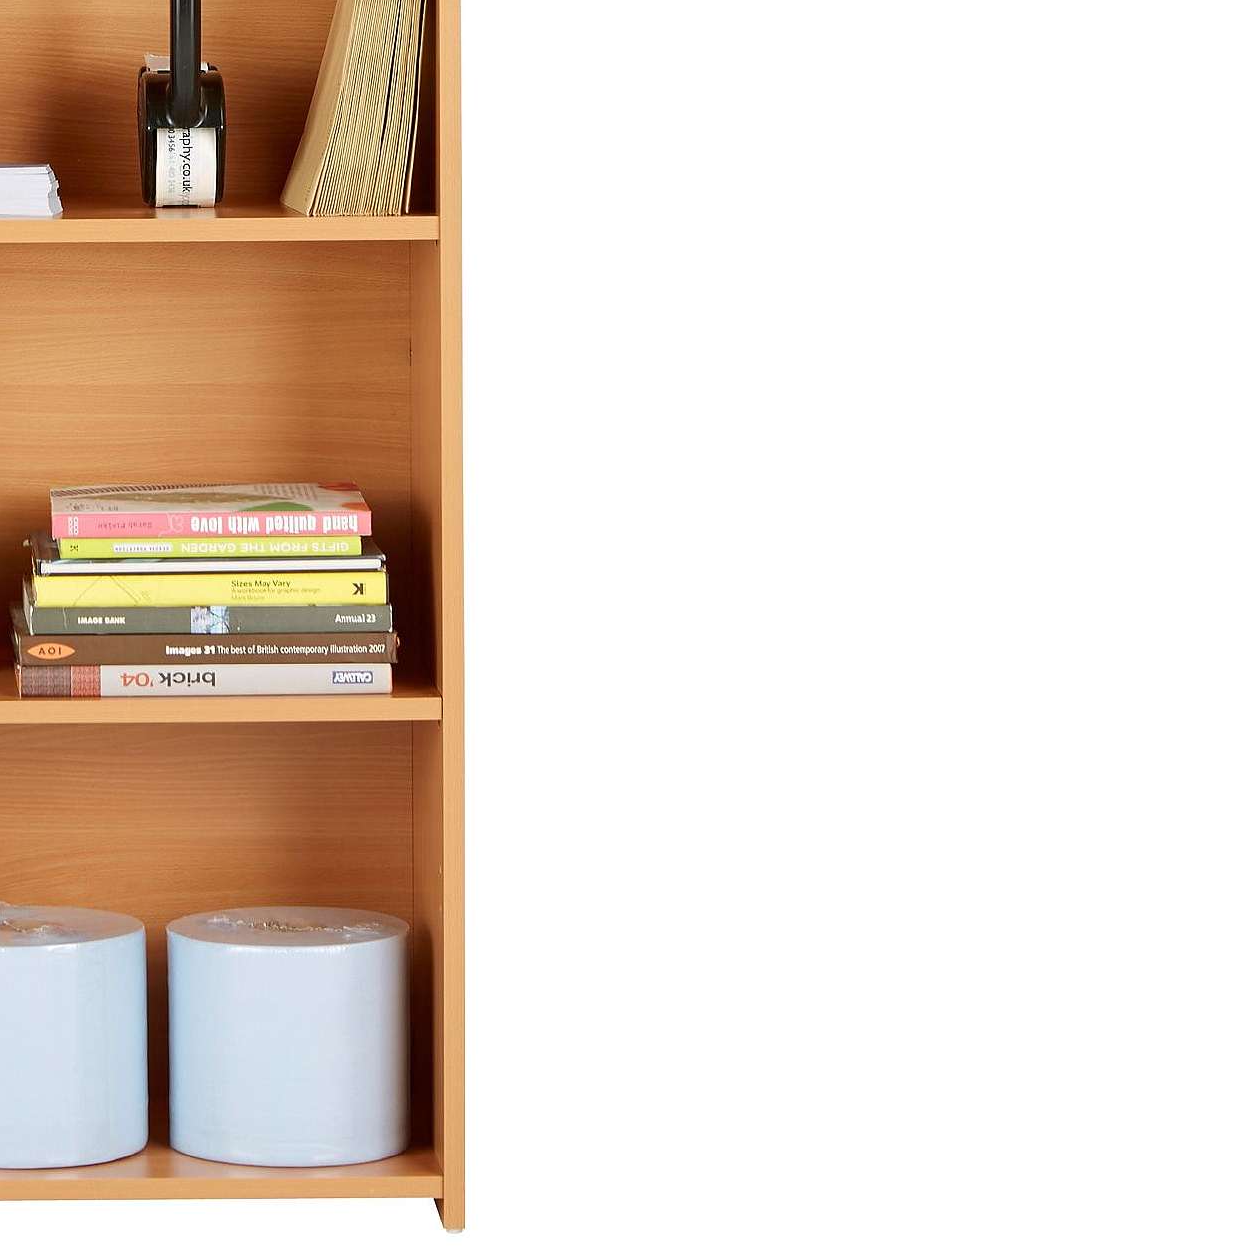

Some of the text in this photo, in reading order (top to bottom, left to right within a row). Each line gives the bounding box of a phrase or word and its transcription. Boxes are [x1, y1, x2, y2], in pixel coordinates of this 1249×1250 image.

[190, 516, 223, 534] love
[228, 516, 260, 534] with
[266, 514, 316, 534] quilted
[323, 515, 358, 534] hand
[181, 543, 237, 553] GARDEN
[240, 543, 264, 553] THE
[270, 542, 307, 552] FROM
[312, 542, 349, 552] GIFTS
[231, 580, 291, 589] Sizes May Vary
[335, 614, 376, 623] Annual 23
[39, 646, 62, 656] AOI
[166, 646, 201, 656] Images
[217, 646, 229, 655] The
[230, 645, 246, 655] best
[248, 645, 256, 655] of
[257, 645, 279, 655] British
[280, 645, 328, 656] contemporary
[330, 644, 367, 654] illustration
[368, 644, 385, 653] 2007
[120, 672, 217, 688] brick '04
[334, 672, 373, 684] CALLWEY
